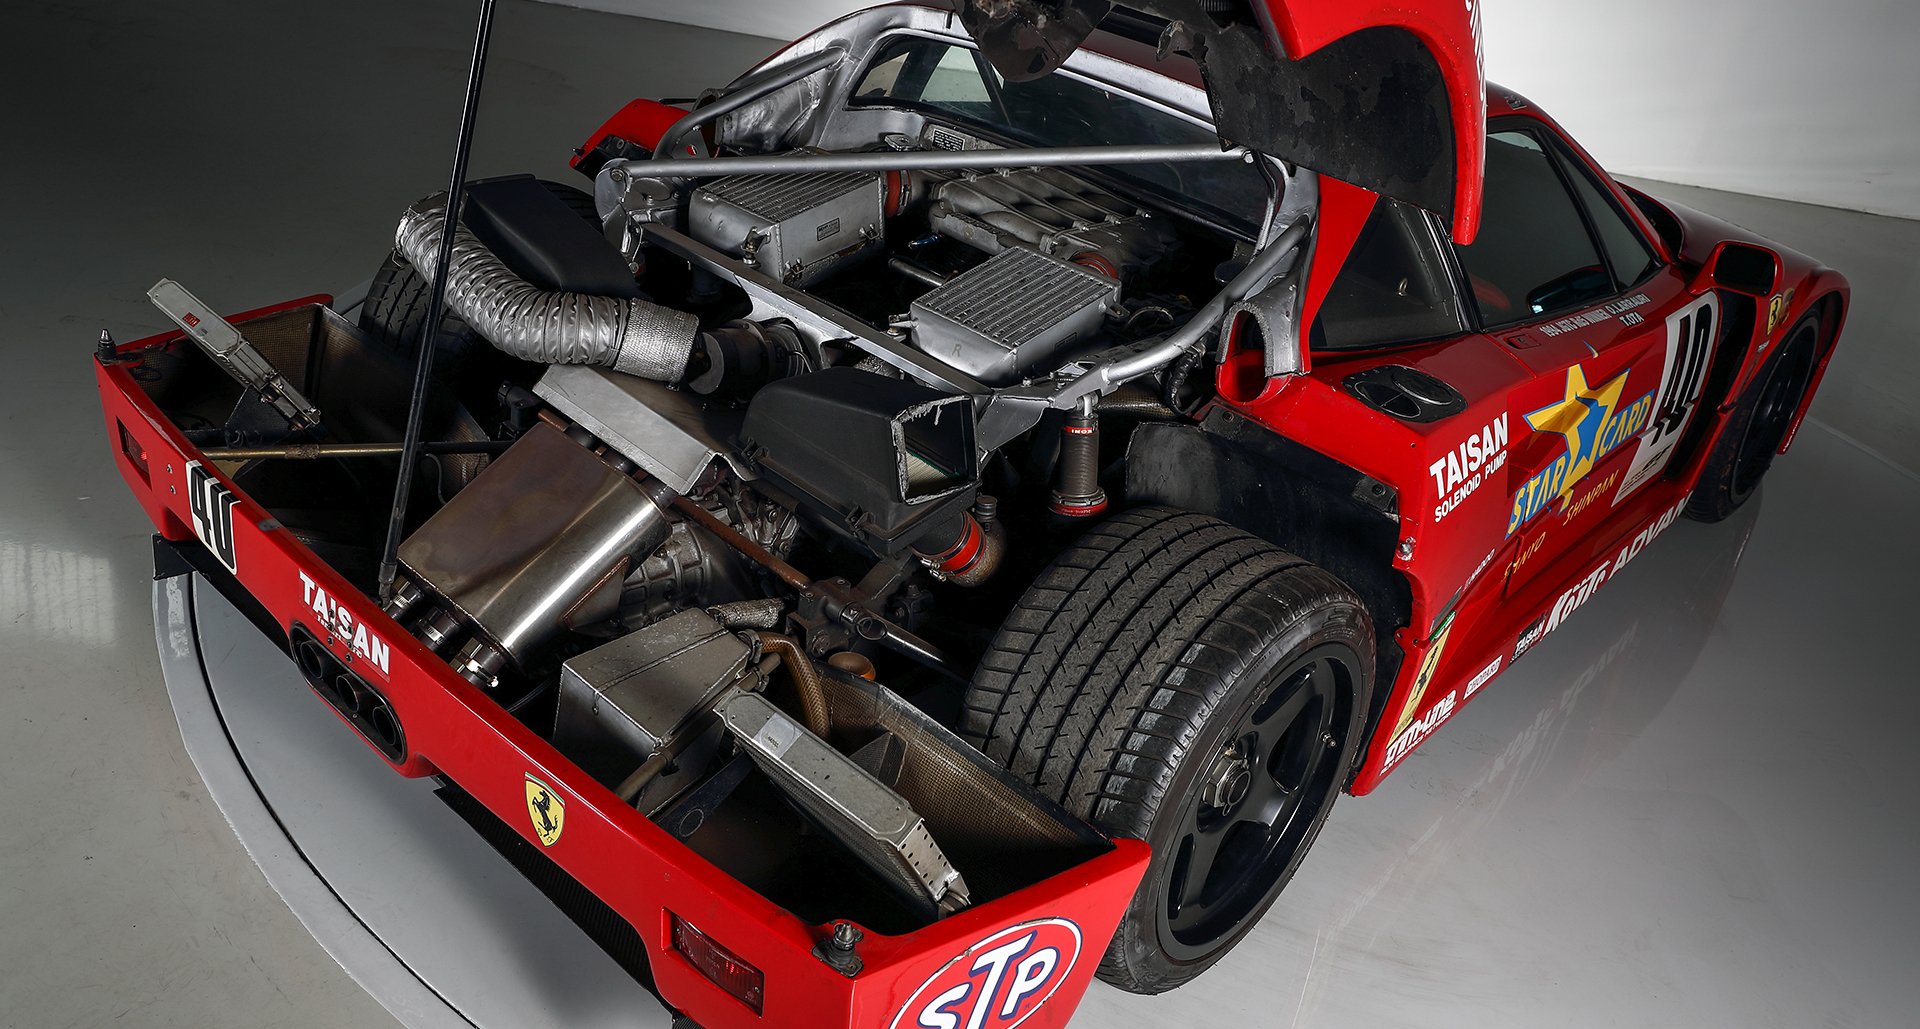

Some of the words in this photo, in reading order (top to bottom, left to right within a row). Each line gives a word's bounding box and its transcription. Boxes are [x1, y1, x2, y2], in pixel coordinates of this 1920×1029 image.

[1619, 311, 1645, 326] T.OTA
[1429, 411, 1508, 500] TAISAN
[1435, 472, 1481, 522] SOLENOID
[1485, 450, 1507, 480] PUMP
[1507, 455, 1567, 534] STAR
[1598, 394, 1652, 458] CARD
[1563, 469, 1620, 526] SHINPAN
[1607, 490, 1694, 580] ADVAN
[299, 570, 390, 675] TAISAN
[917, 930, 1061, 1029] STP
